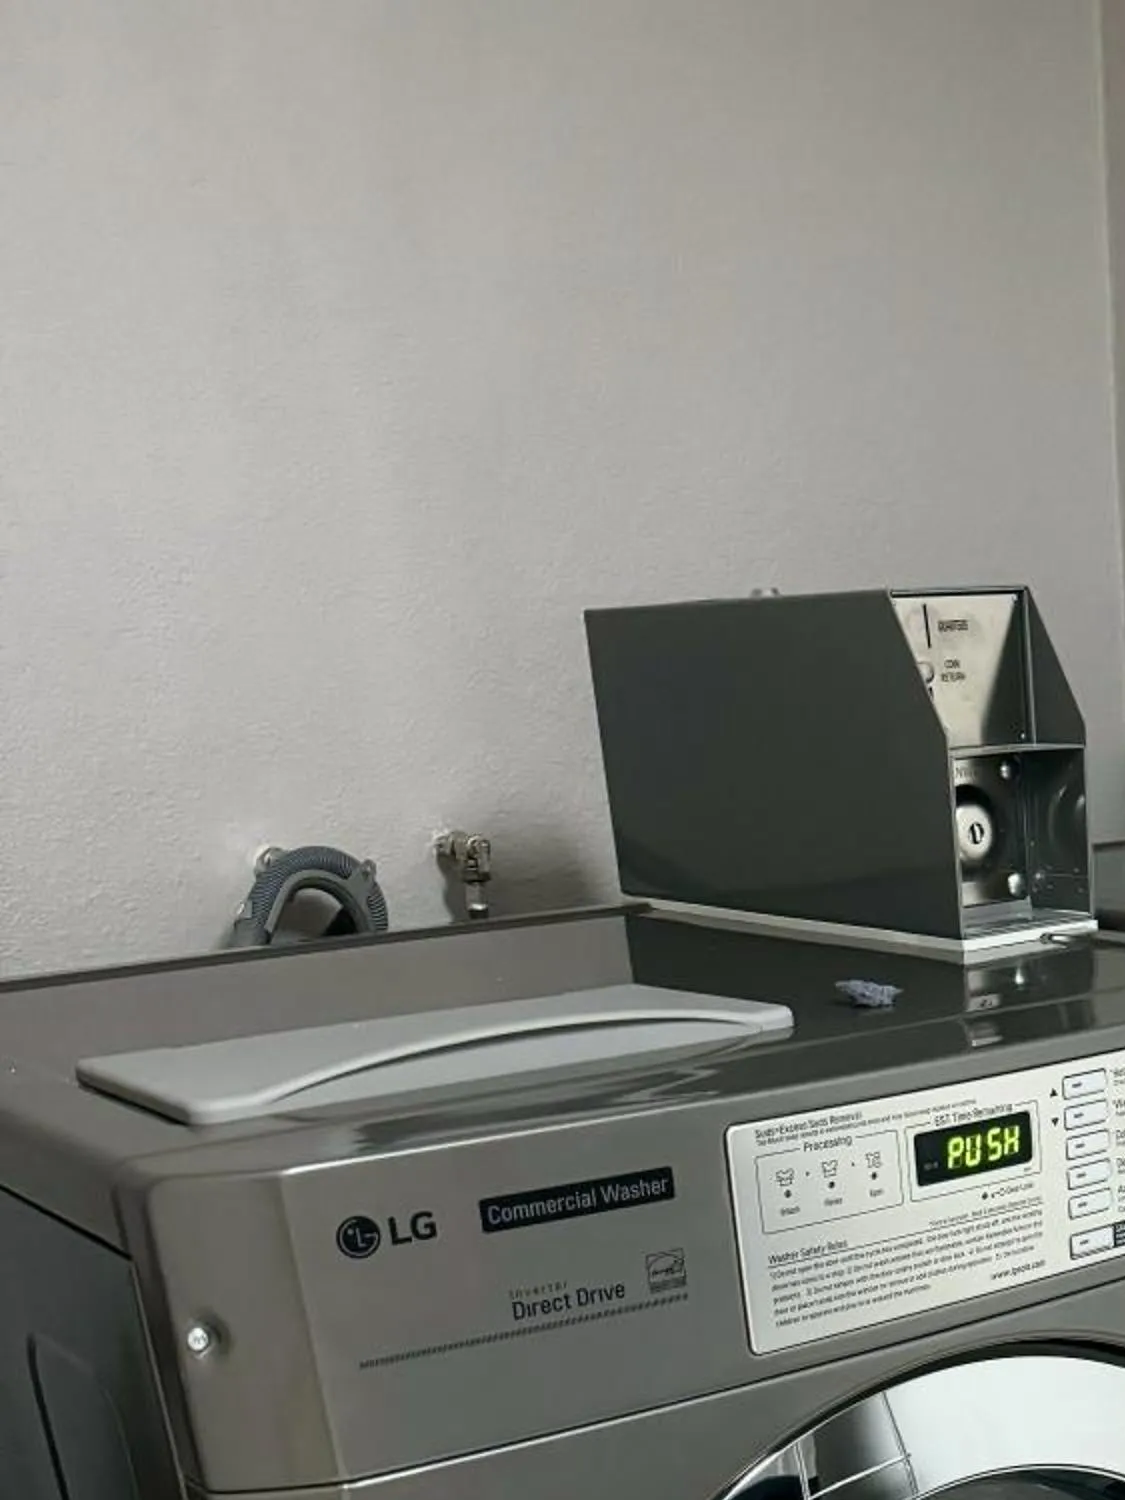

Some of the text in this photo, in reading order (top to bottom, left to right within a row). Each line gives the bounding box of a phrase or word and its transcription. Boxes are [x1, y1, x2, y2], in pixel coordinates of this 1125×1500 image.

[803, 1135, 853, 1152] Processing
[947, 1125, 1020, 1169] PUSH
[486, 1176, 669, 1226] Commercial Washer
[388, 1211, 437, 1246] LG
[512, 1293, 572, 1321] Direct
[576, 1282, 626, 1307] Drive
